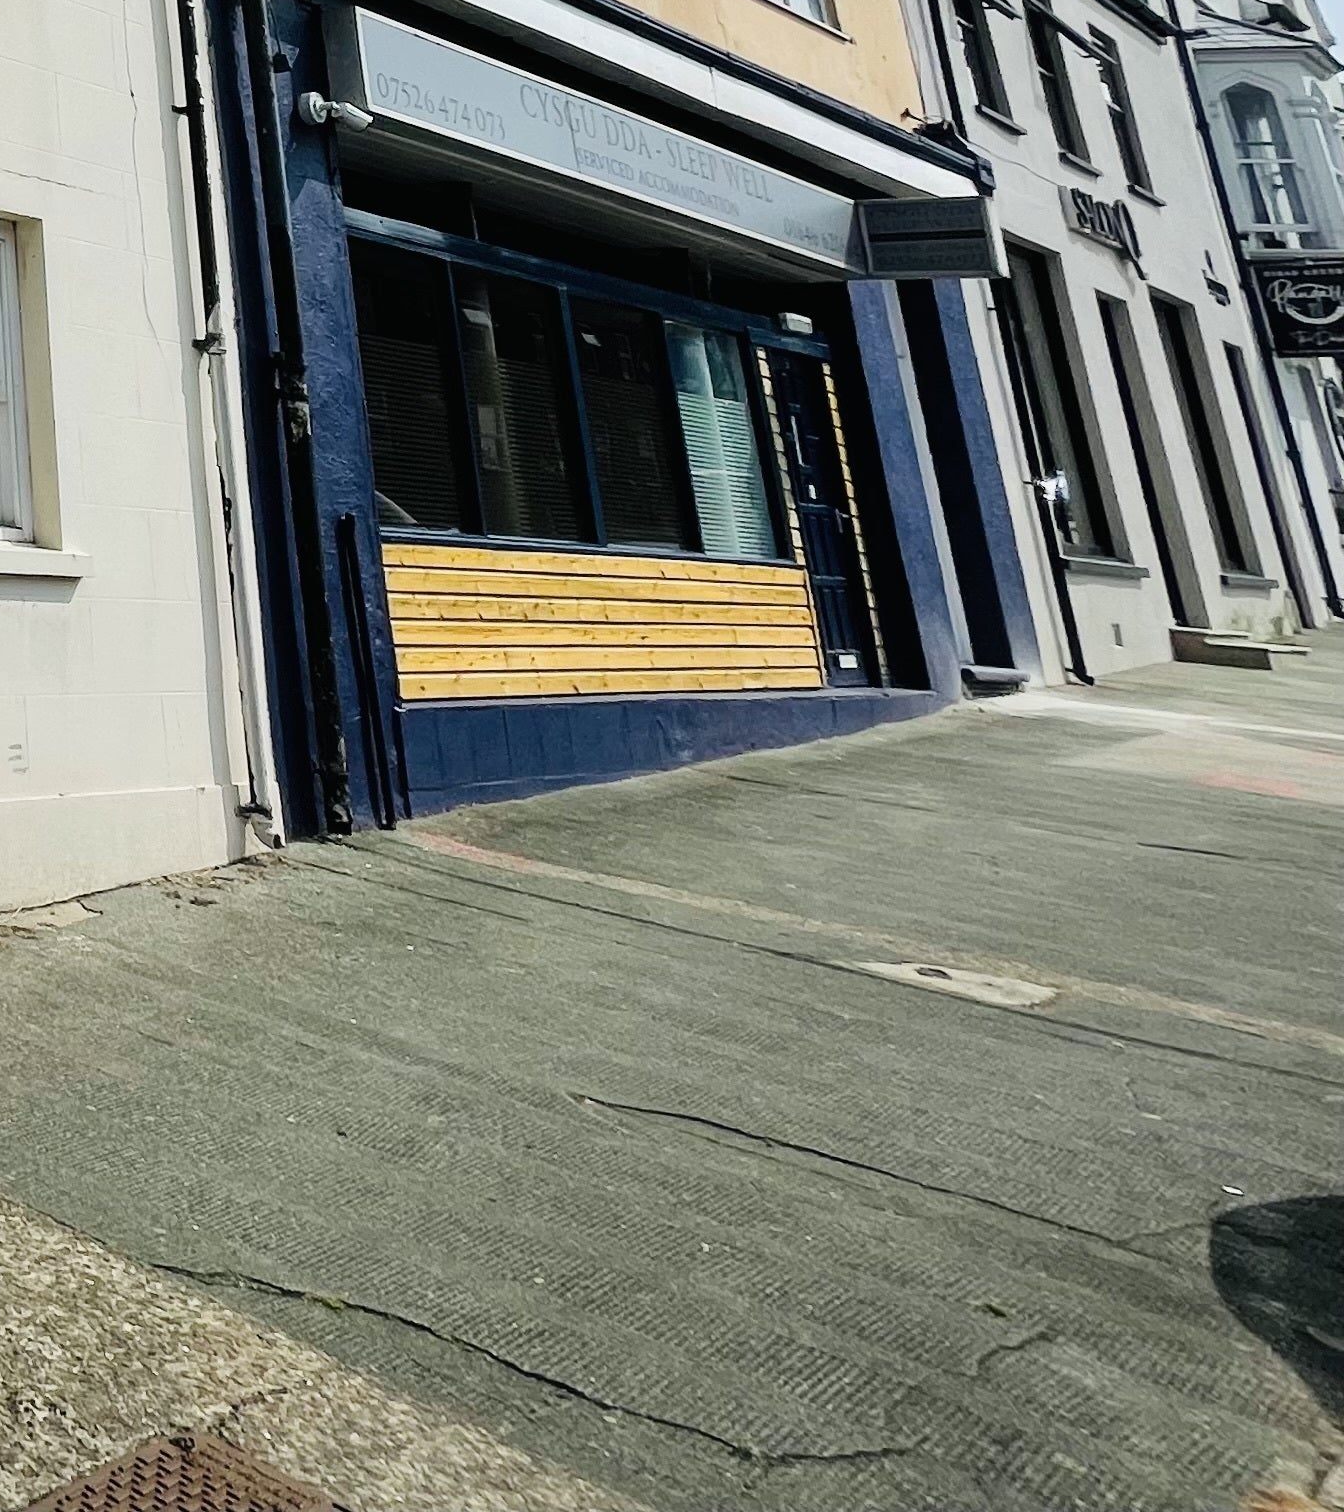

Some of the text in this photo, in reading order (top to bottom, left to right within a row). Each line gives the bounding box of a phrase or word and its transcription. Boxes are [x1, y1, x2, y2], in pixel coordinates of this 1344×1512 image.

[520, 83, 597, 139] CYSGU
[602, 112, 652, 159] DDA
[665, 137, 716, 183] SLEEP
[721, 157, 774, 203] WELL
[577, 147, 635, 181] SERVICED
